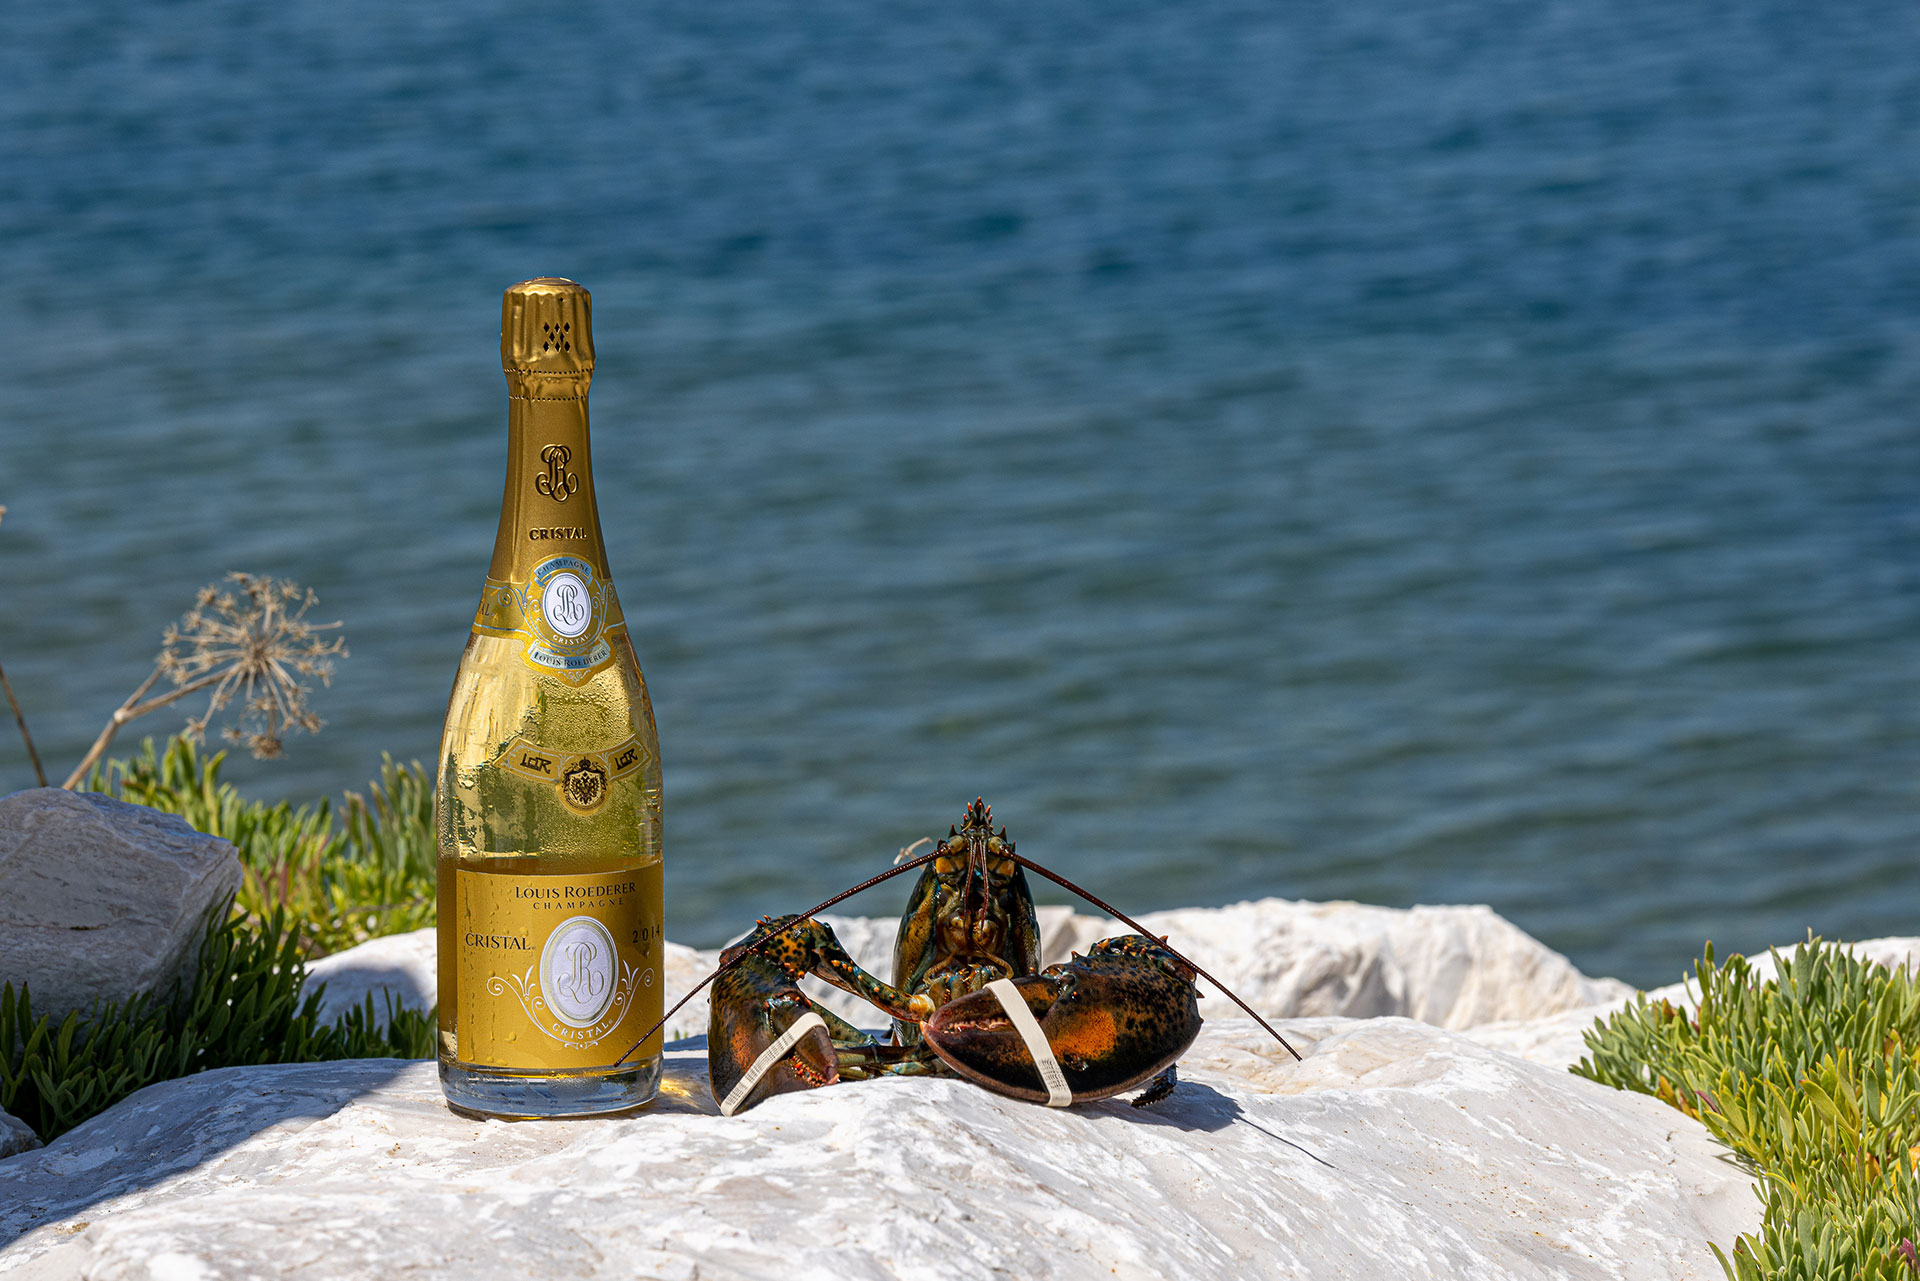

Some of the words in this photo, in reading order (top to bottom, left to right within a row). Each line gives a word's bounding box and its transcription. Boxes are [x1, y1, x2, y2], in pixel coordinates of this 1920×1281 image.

[529, 527, 587, 541] CRISTAL
[536, 559, 590, 576] CHAMPAGNE
[552, 633, 588, 645] CRISTAL
[533, 651, 561, 666] LOUIS
[564, 649, 607, 667] ROEDERER
[515, 886, 560, 899] LOUIS
[564, 881, 636, 899] ROEDERER
[532, 897, 624, 910] CHAMPAGNE
[465, 932, 532, 950] CRISTAL
[632, 924, 660, 944] 2014
[551, 1021, 610, 1040] CRISTAL
